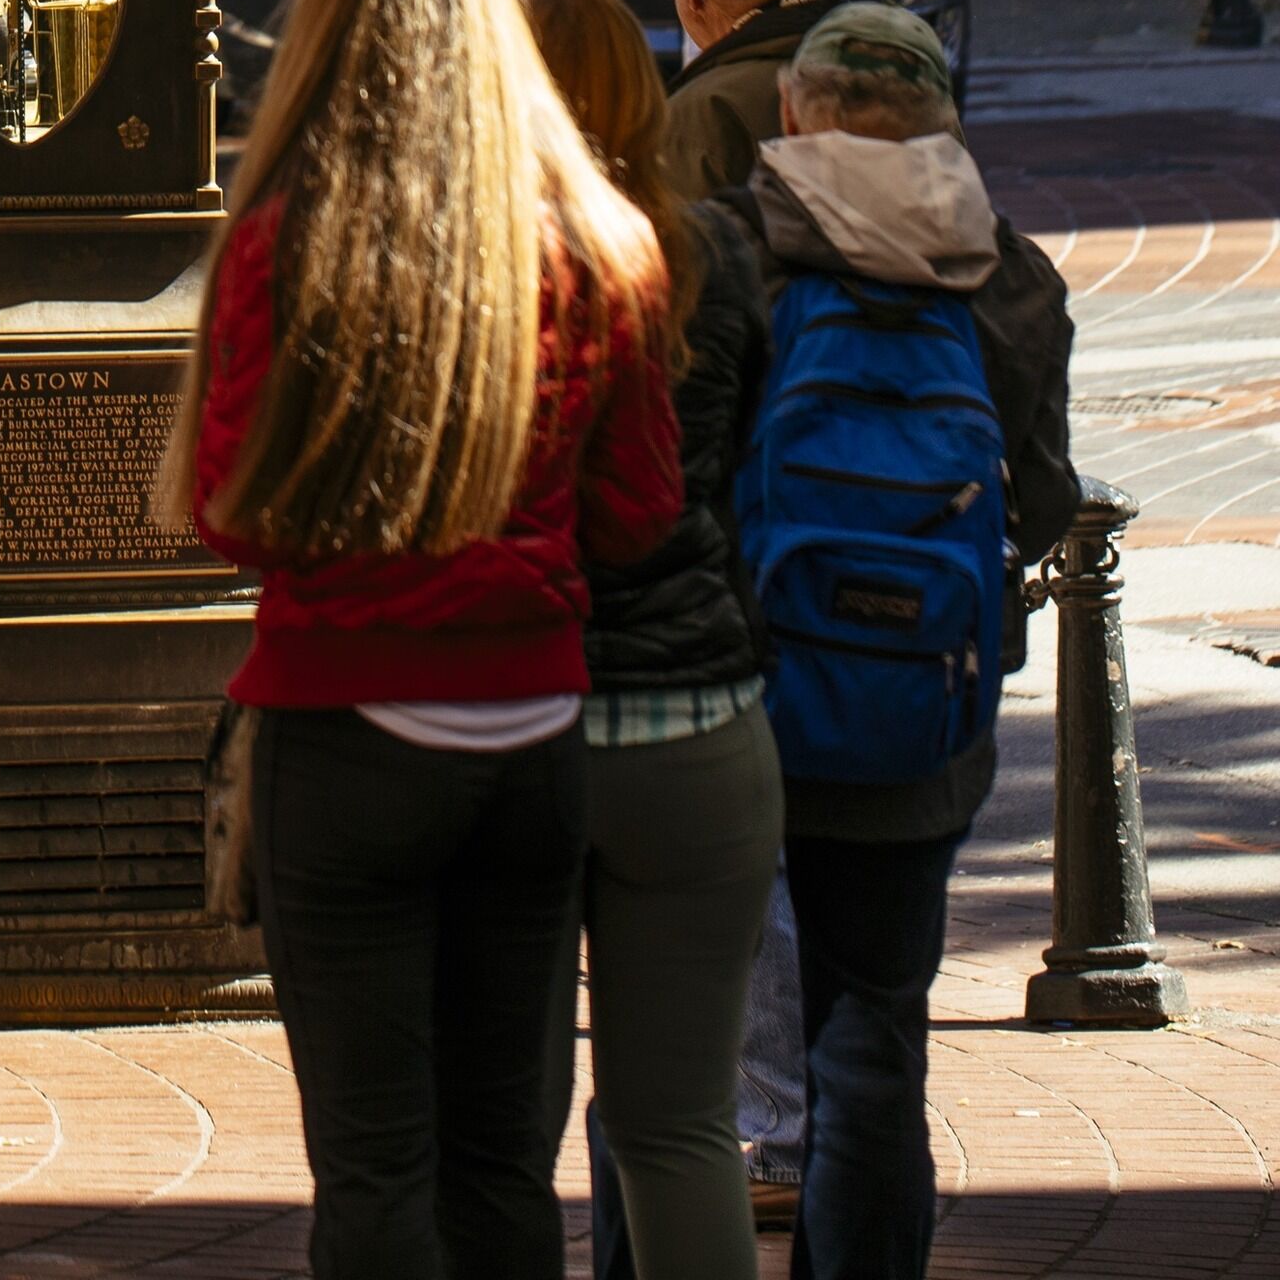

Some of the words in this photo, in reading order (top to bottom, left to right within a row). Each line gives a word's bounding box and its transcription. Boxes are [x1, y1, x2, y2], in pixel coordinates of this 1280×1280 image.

[48, 396, 62, 406] AT
[66, 396, 88, 406] THE
[93, 394, 147, 405] WESTERN
[153, 394, 184, 404] BOUN
[87, 406, 133, 417] KNOWN
[138, 406, 152, 416] AS
[8, 419, 66, 430] BURRARD
[70, 418, 106, 428] INLET
[112, 418, 136, 427] WAS
[141, 417, 174, 427] ONLY
[51, 429, 106, 440] THROUGH
[71, 440, 119, 450] CENTRE
[125, 440, 141, 449] OF
[145, 439, 169, 449] VAN
[48, 452, 69, 461] THE
[73, 451, 118, 461] CENTRE
[123, 450, 137, 460] OF
[141, 450, 164, 460] VAN
[66, 462, 78, 472] IT
[81, 462, 105, 472] WAS
[2, 475, 24, 485] THE
[28, 474, 75, 484] SUCCESS
[79, 473, 93, 483] OF
[97, 473, 113, 482] ITS
[141, 483, 157, 493] AN
[8, 496, 69, 507] WORKING
[77, 494, 140, 505] TOGETHER
[117, 505, 140, 515] THE
[21, 518, 35, 528] OF
[42, 517, 64, 527] THE
[73, 515, 136, 527] PROPERTY
[61, 528, 85, 538] FOR
[91, 528, 112, 537] THE
[23, 539, 69, 550] PARKER
[72, 538, 116, 549] SERVED
[119, 537, 132, 548] AS
[135, 536, 200, 547] CHAIRMAN
[65, 551, 92, 561] 1967
[97, 550, 112, 560] TO
